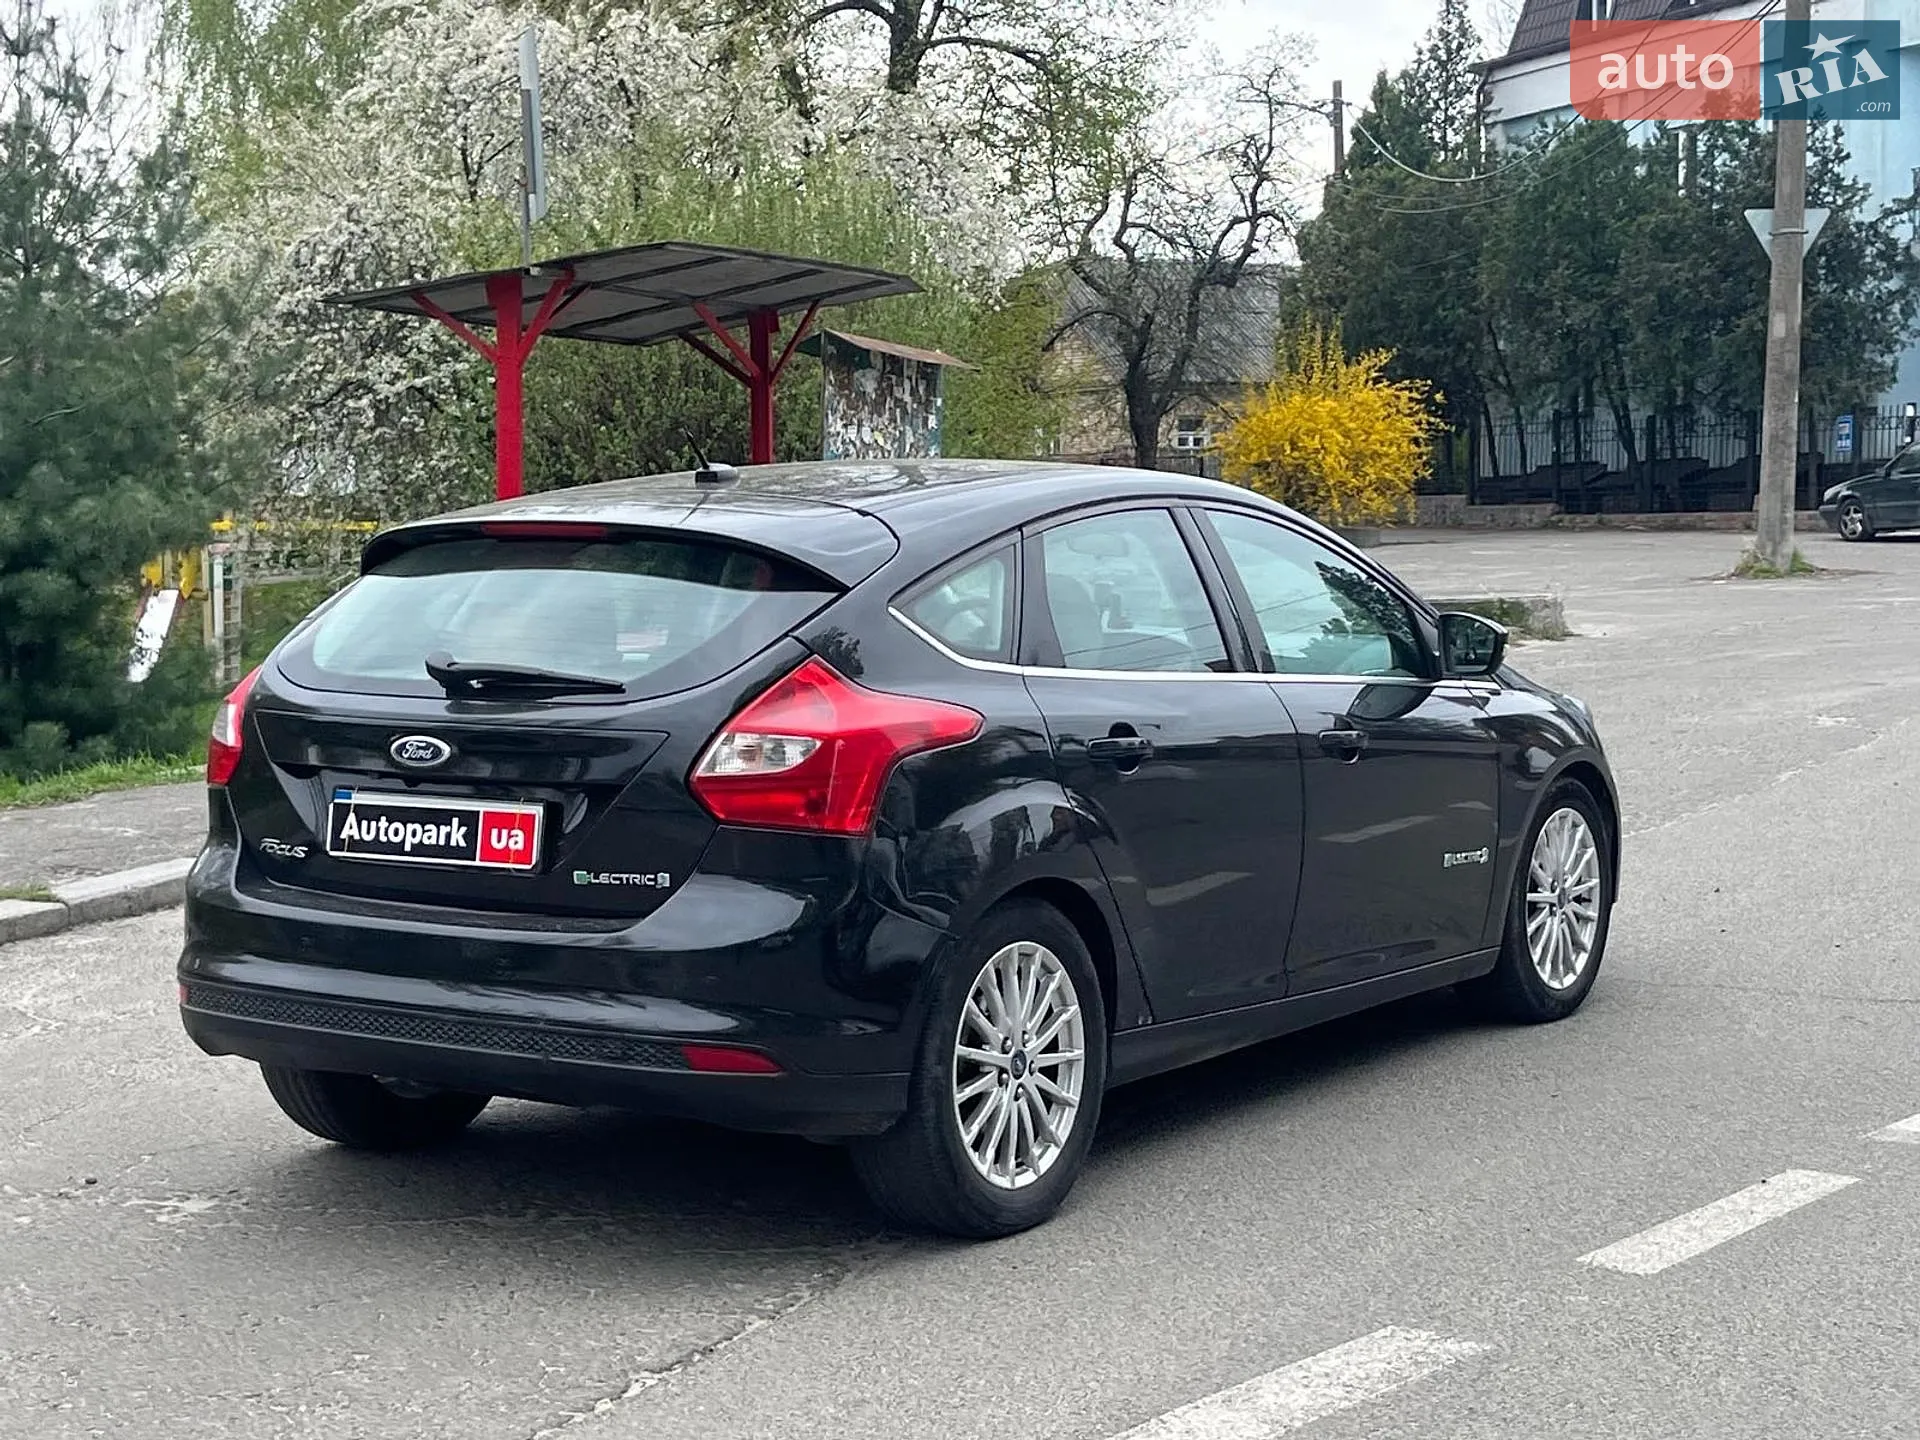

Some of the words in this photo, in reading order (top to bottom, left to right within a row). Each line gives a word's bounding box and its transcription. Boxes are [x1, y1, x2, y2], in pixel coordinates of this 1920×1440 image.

[402, 741, 434, 759] Ford
[340, 811, 467, 852] Autopark
[491, 827, 525, 851] ua
